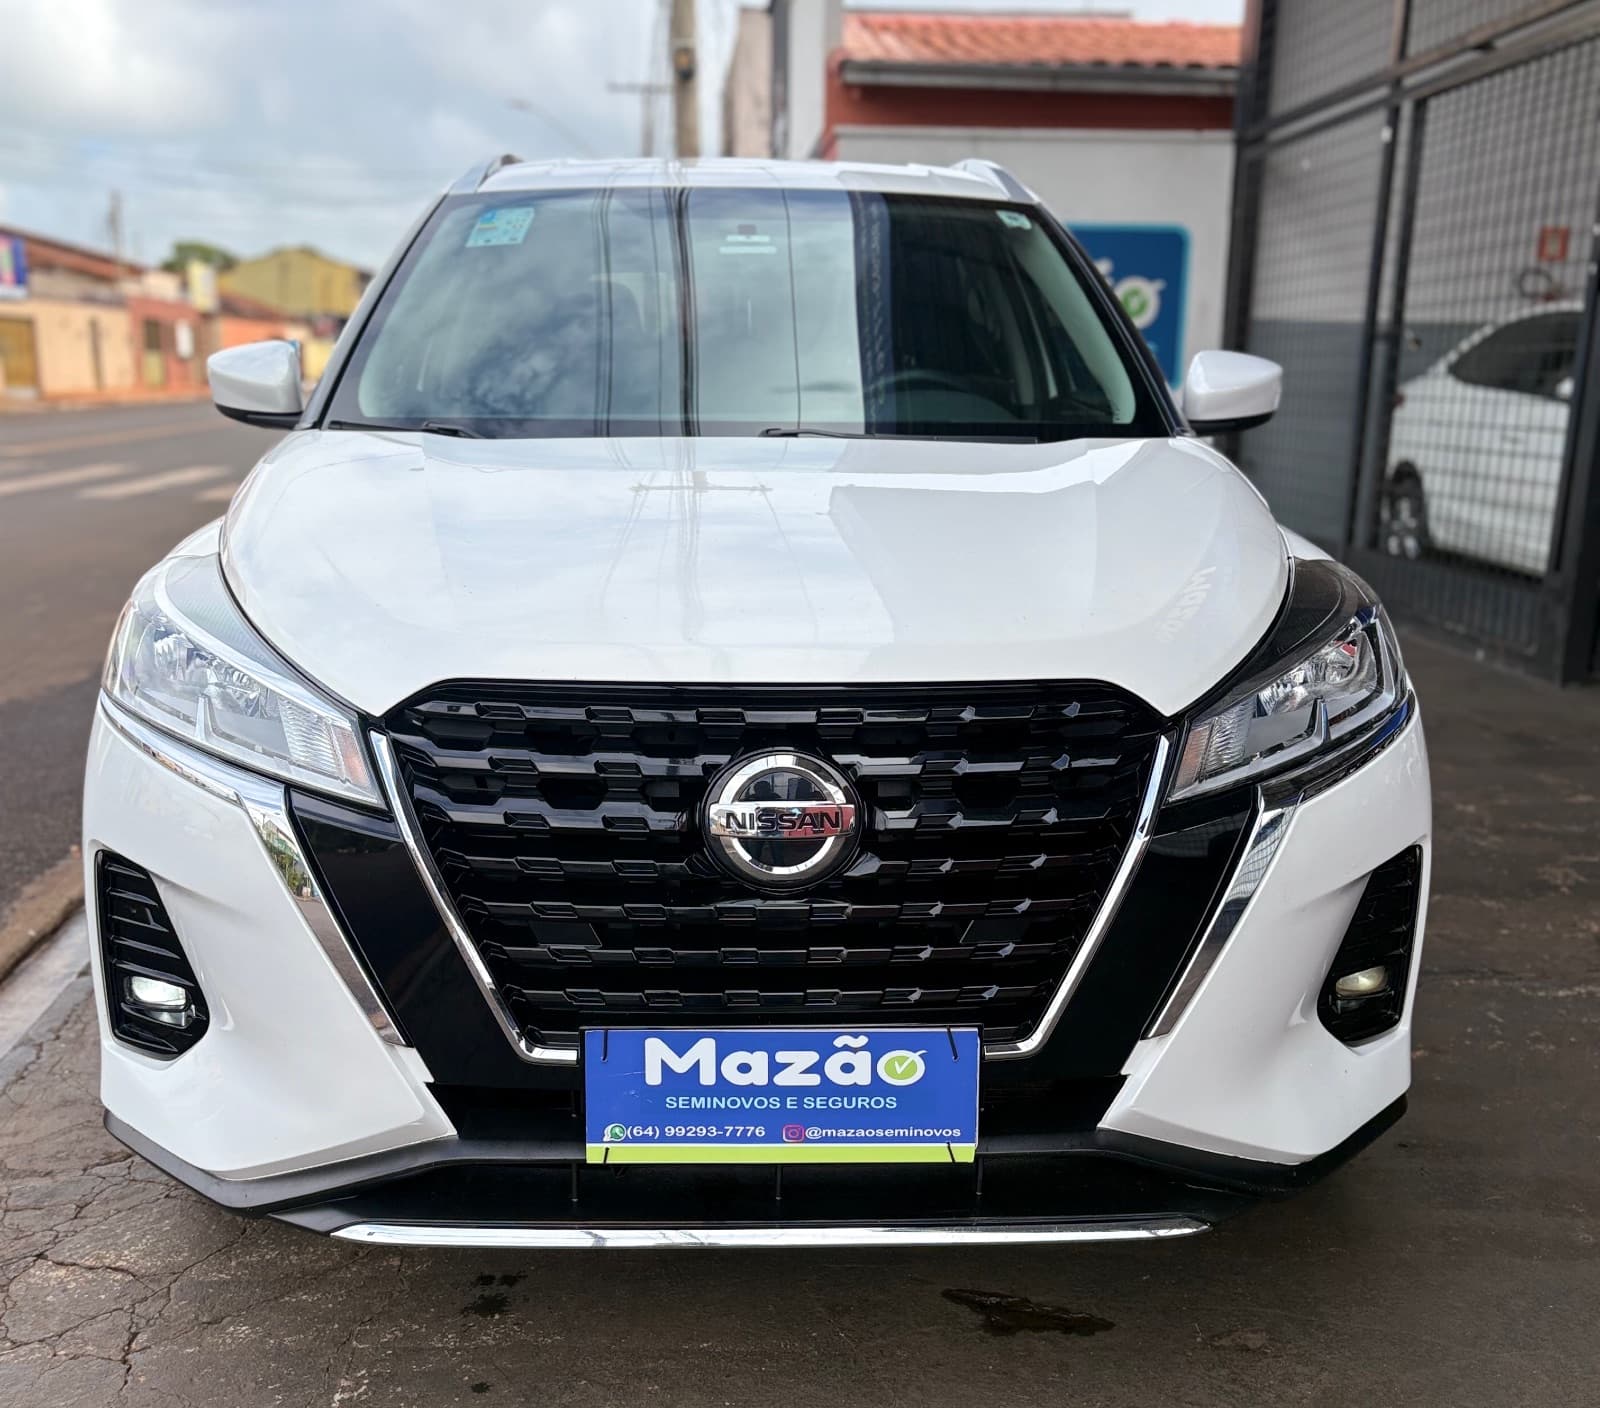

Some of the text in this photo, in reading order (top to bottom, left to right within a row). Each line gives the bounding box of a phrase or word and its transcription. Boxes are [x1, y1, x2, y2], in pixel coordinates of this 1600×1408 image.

[725, 812, 840, 831] NISSAN
[644, 1035, 927, 1086] Mazão
[665, 1096, 897, 1109] SEMINOVOS E SEGUROS
[626, 1125, 962, 1140] (64) 99293-7776 @mazaoseminovos
